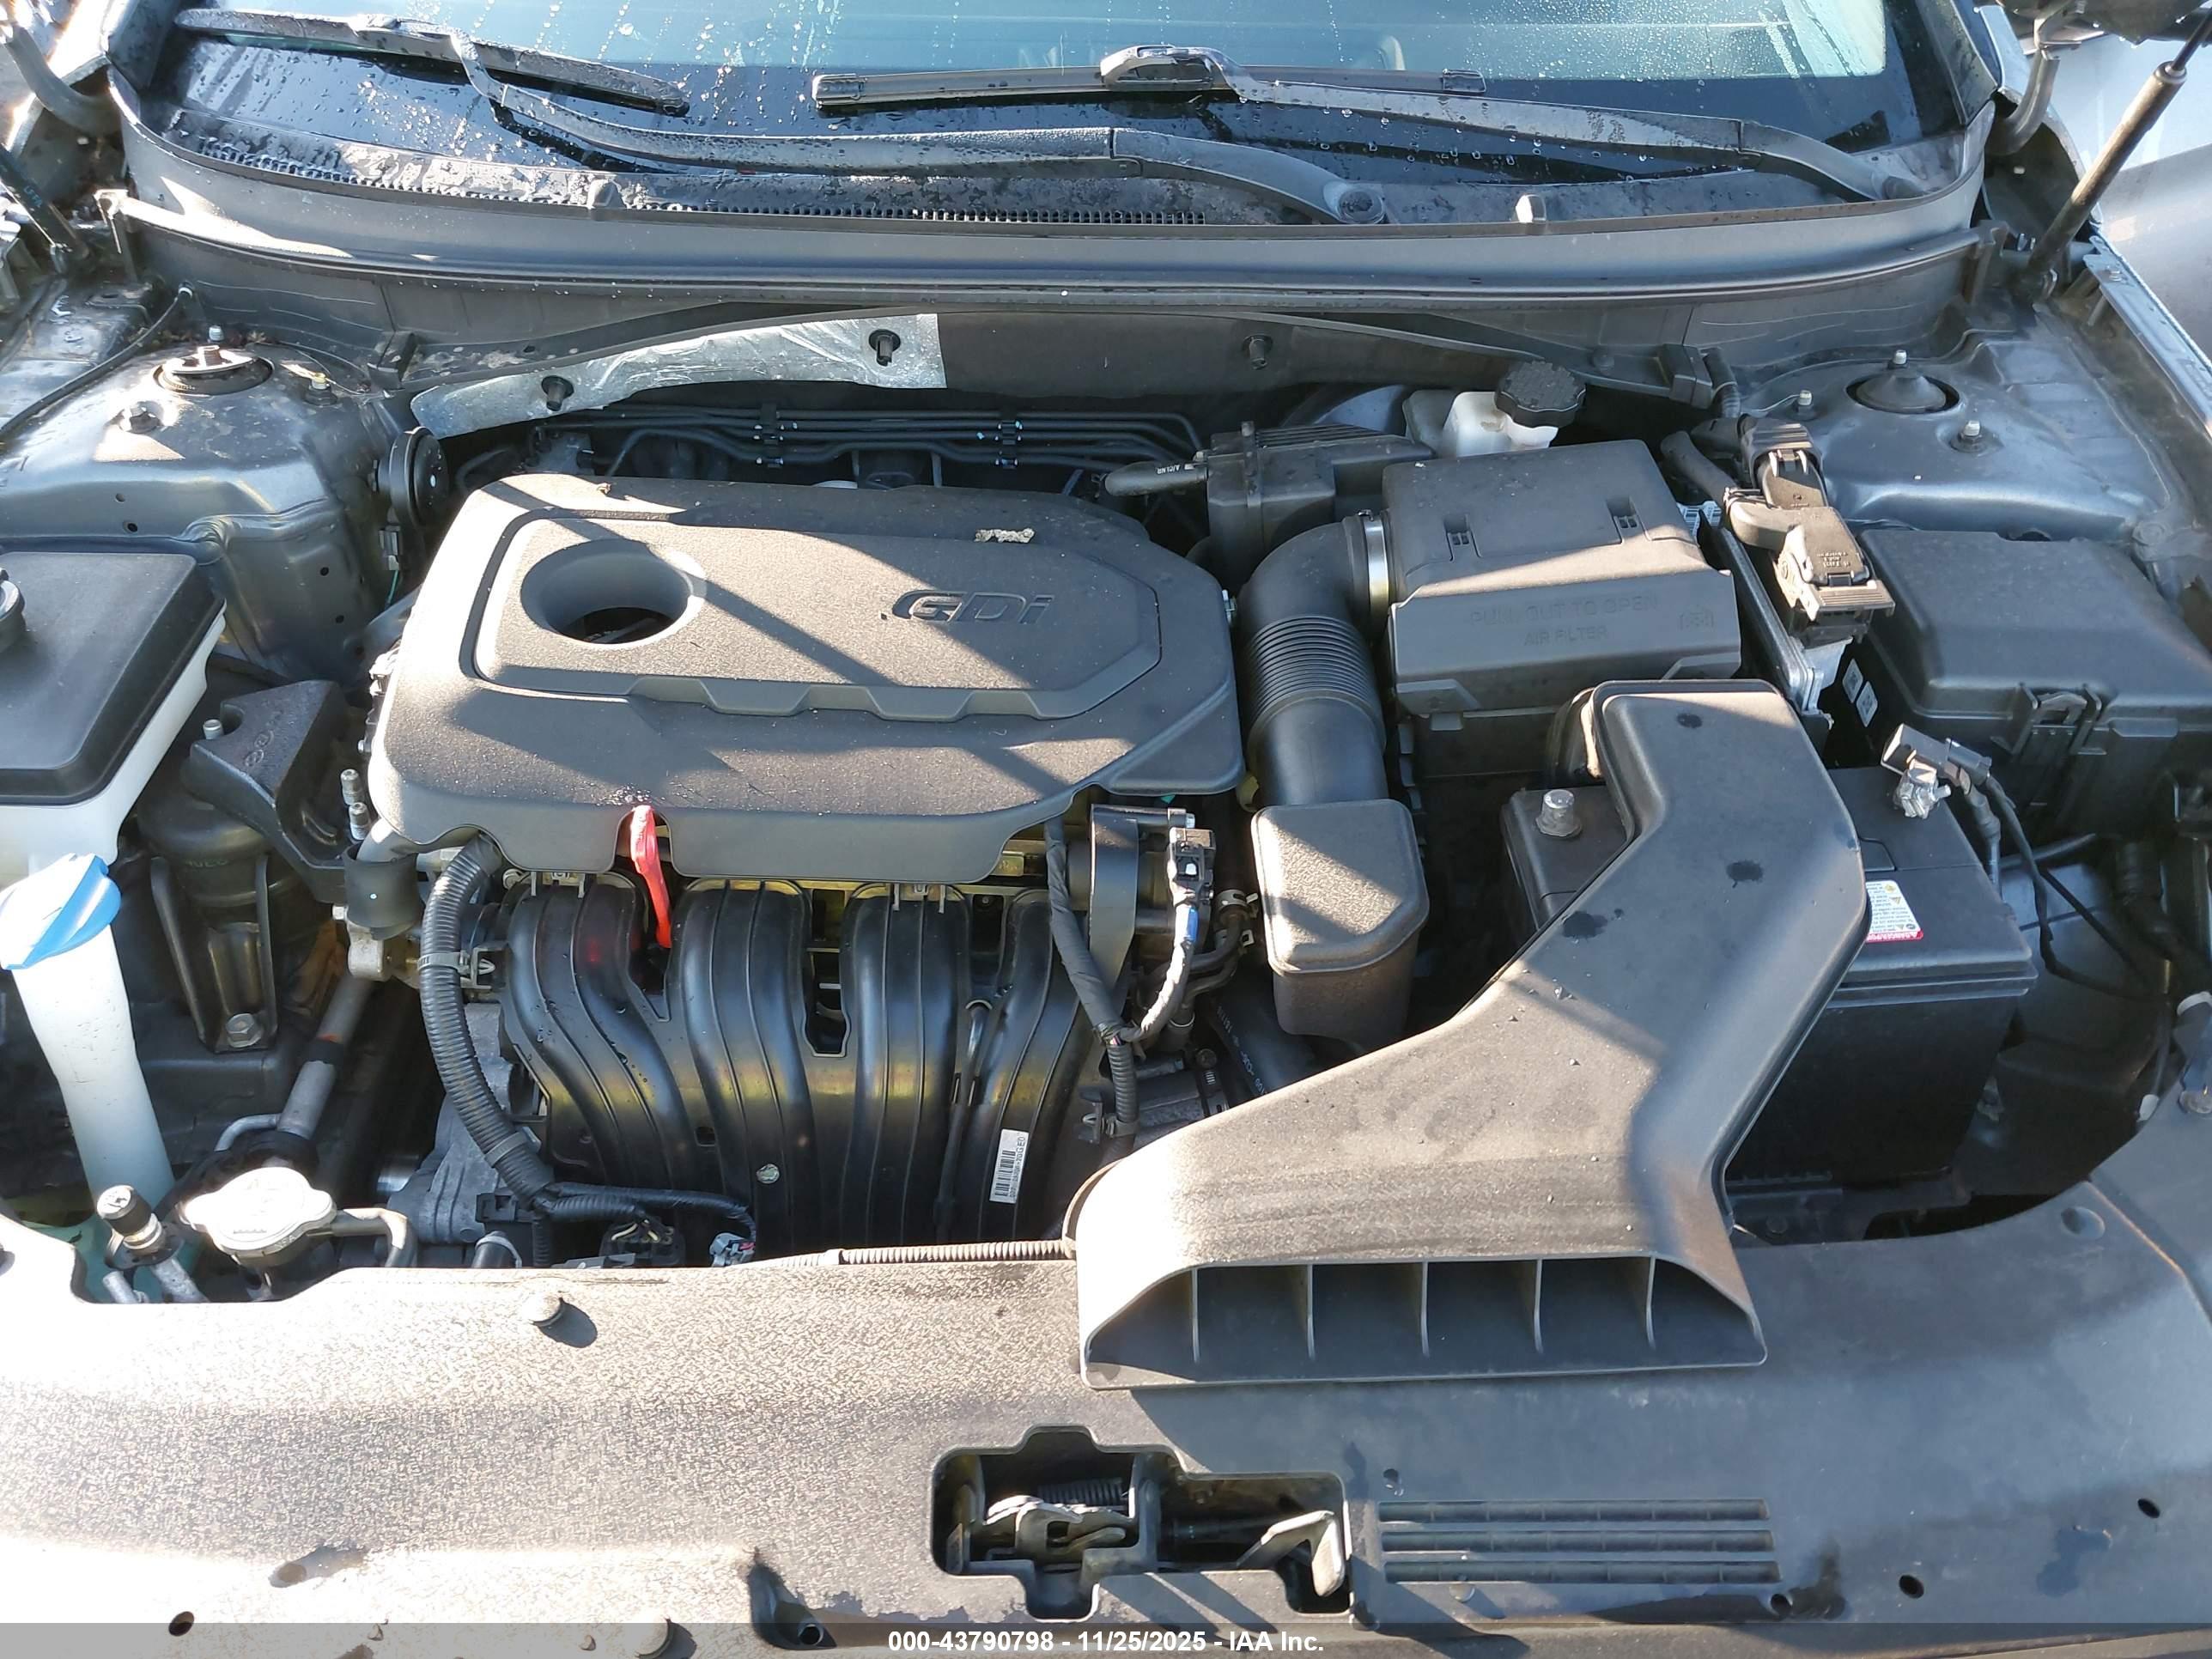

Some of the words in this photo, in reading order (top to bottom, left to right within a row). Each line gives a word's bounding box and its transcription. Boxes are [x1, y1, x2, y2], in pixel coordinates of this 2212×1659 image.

[1571, 599, 1598, 617] TO
[1523, 629, 1550, 646] AIR
[1555, 624, 1610, 642] FILTER
